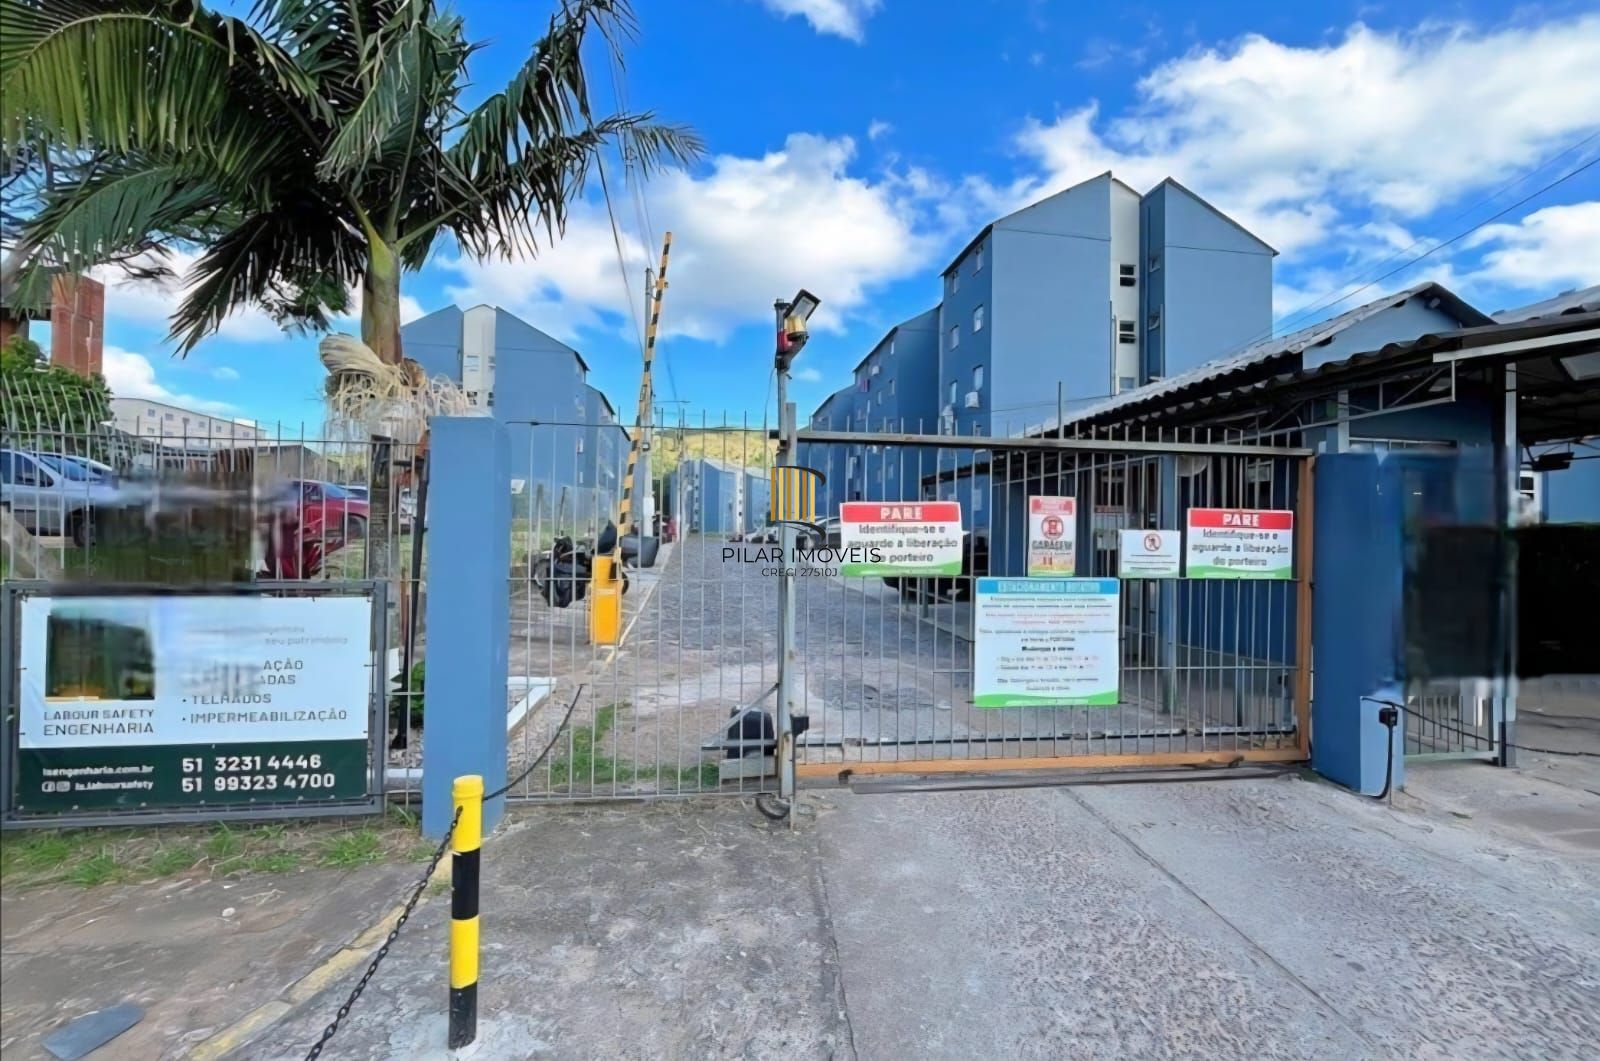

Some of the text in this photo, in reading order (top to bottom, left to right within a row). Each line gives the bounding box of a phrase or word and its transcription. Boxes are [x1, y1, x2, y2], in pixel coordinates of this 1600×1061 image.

[880, 507, 922, 520] PARE
[1223, 513, 1260, 526] PARE
[44, 709, 154, 721] LABOUR SAFETY
[190, 708, 347, 724] IMPERMEABILIZAÇÃO
[44, 722, 154, 736] ENGENHARIA
[182, 754, 322, 773] 51 3231 4446
[182, 773, 336, 793] 51 99323 4700
